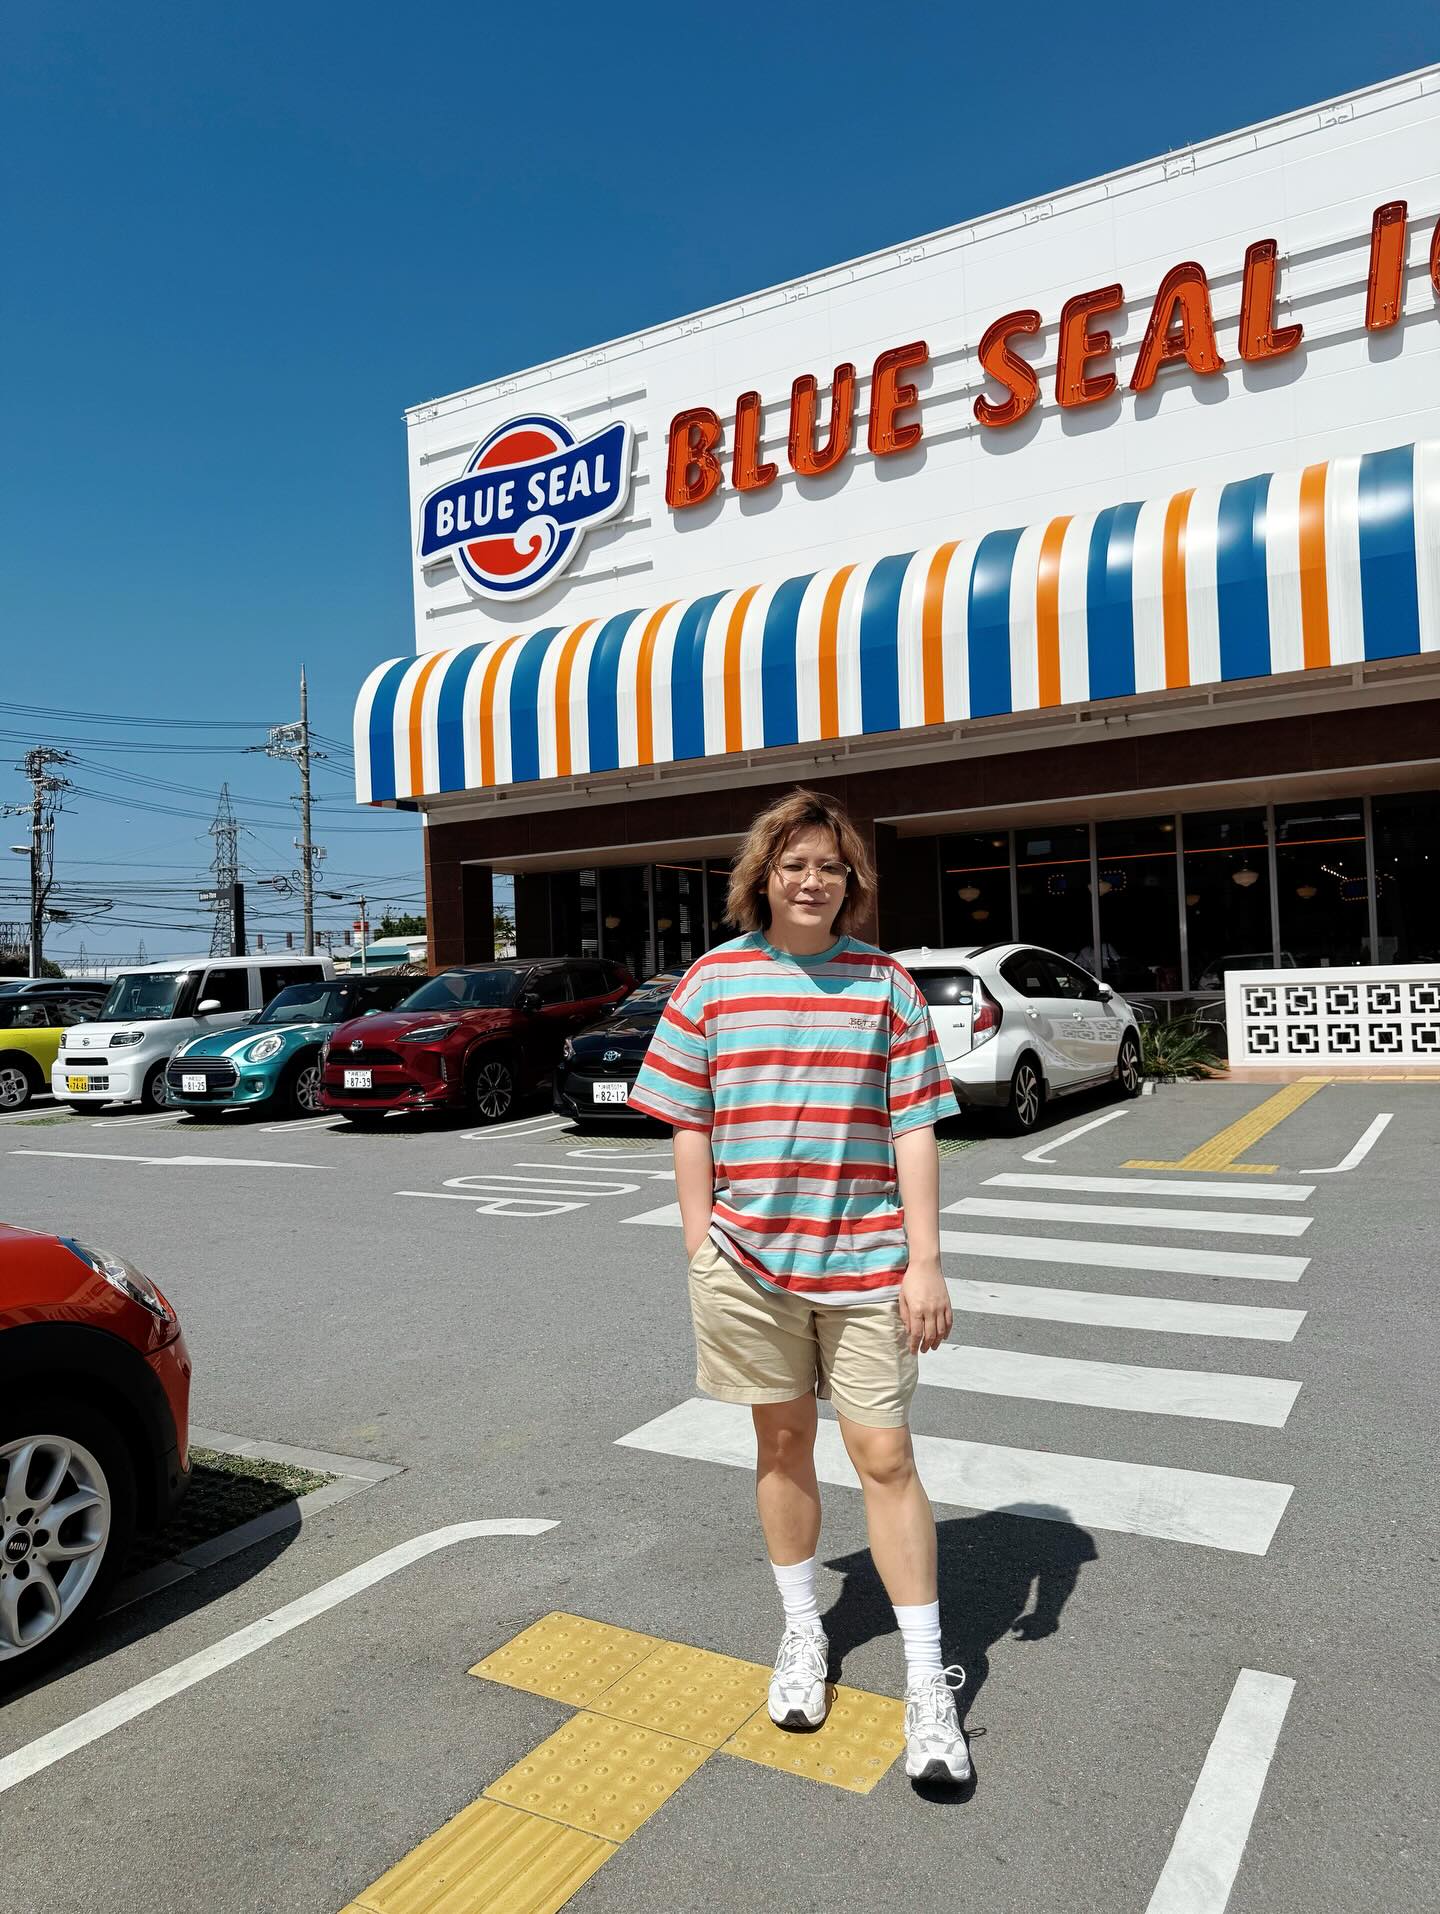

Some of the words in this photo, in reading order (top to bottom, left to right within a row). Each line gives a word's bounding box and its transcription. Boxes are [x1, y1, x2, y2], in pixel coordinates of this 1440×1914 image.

[665, 340, 929, 509] BLUE
[973, 238, 1304, 427] SEAL
[1365, 200, 1440, 333] I
[436, 480, 515, 537] BLUE
[526, 454, 611, 512] SEAL
[187, 1081, 205, 1091] 81-25
[350, 1077, 371, 1087] 87-39
[601, 1091, 626, 1101] 82-12
[9, 1541, 27, 1551] MINI
